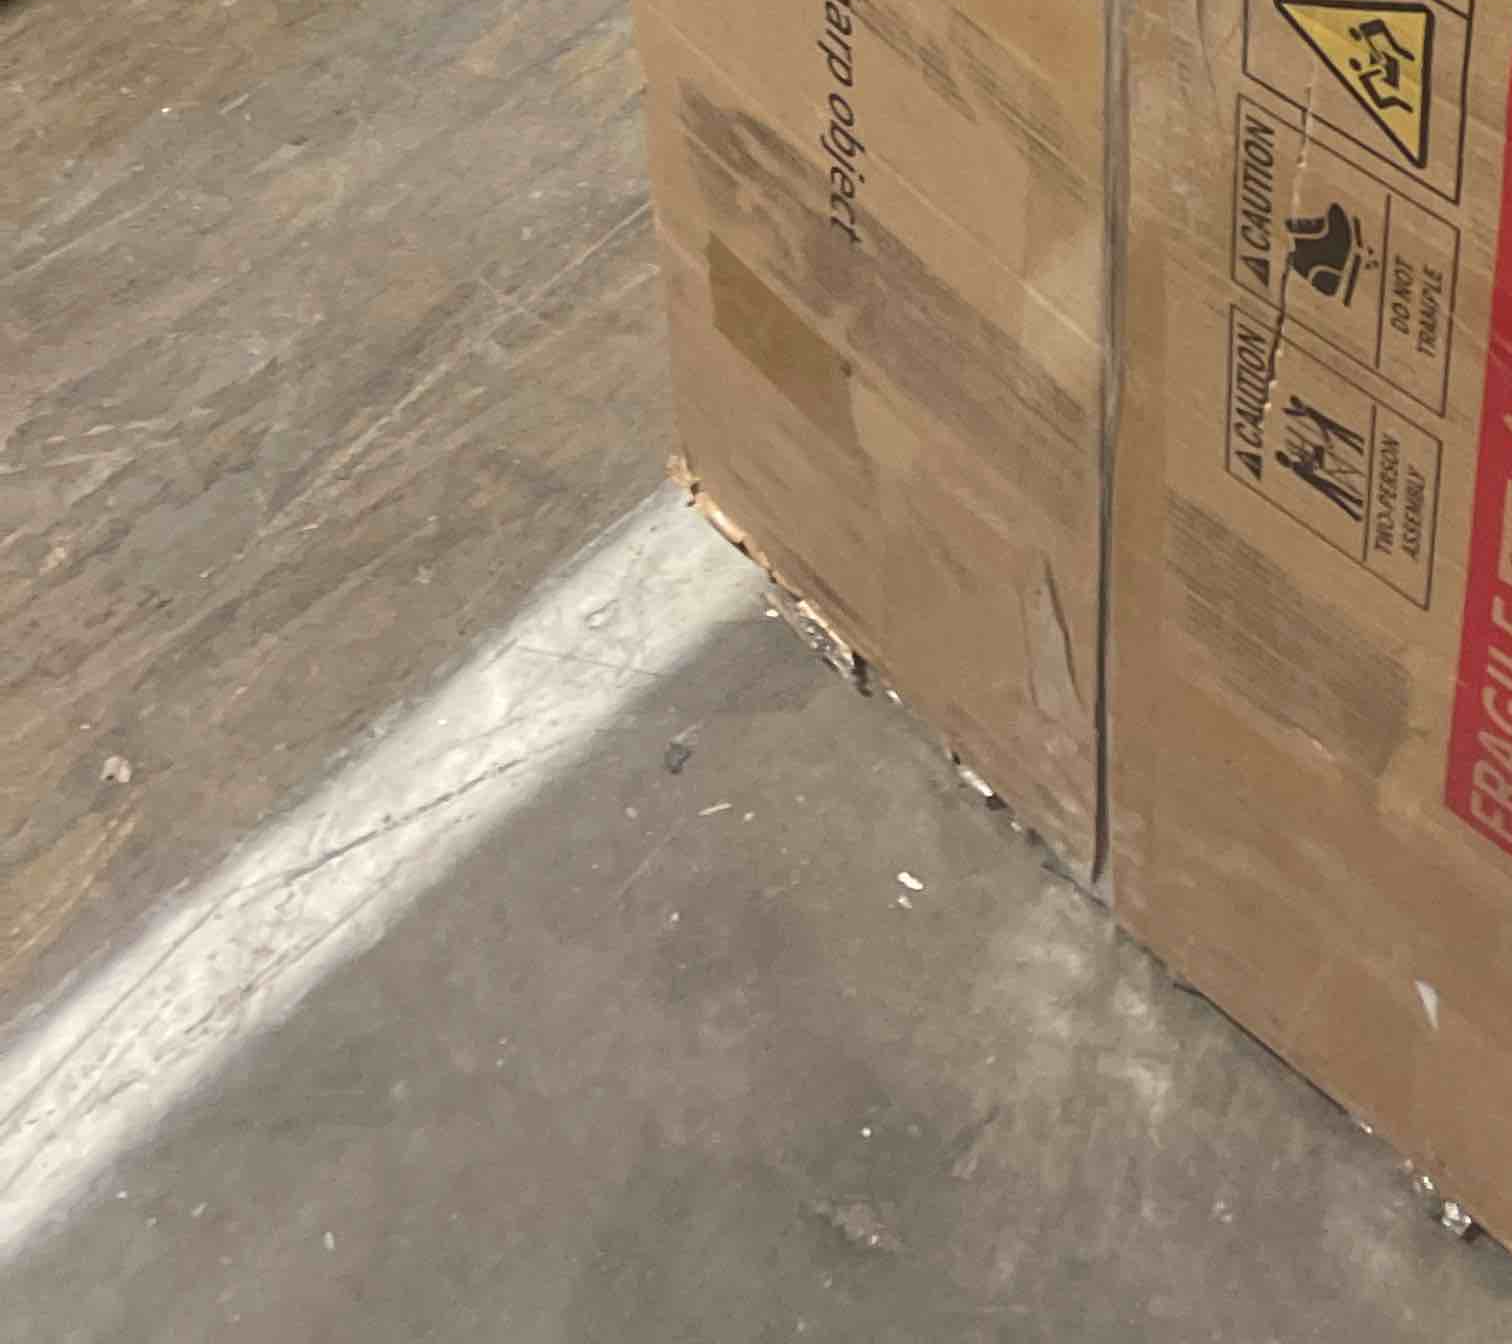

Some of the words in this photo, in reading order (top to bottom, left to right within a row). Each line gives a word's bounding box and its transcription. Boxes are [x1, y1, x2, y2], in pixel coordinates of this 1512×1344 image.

[820, 92, 865, 248] object
[1238, 116, 1277, 253] CAUTION
[1390, 302, 1412, 336] DO
[1395, 256, 1415, 302] NOT
[1417, 262, 1444, 358] TRAMPLE
[1232, 325, 1270, 452] CAUTION
[1373, 432, 1401, 556] TWO-PERSON
[1401, 468, 1428, 561] ASSEMBLY
